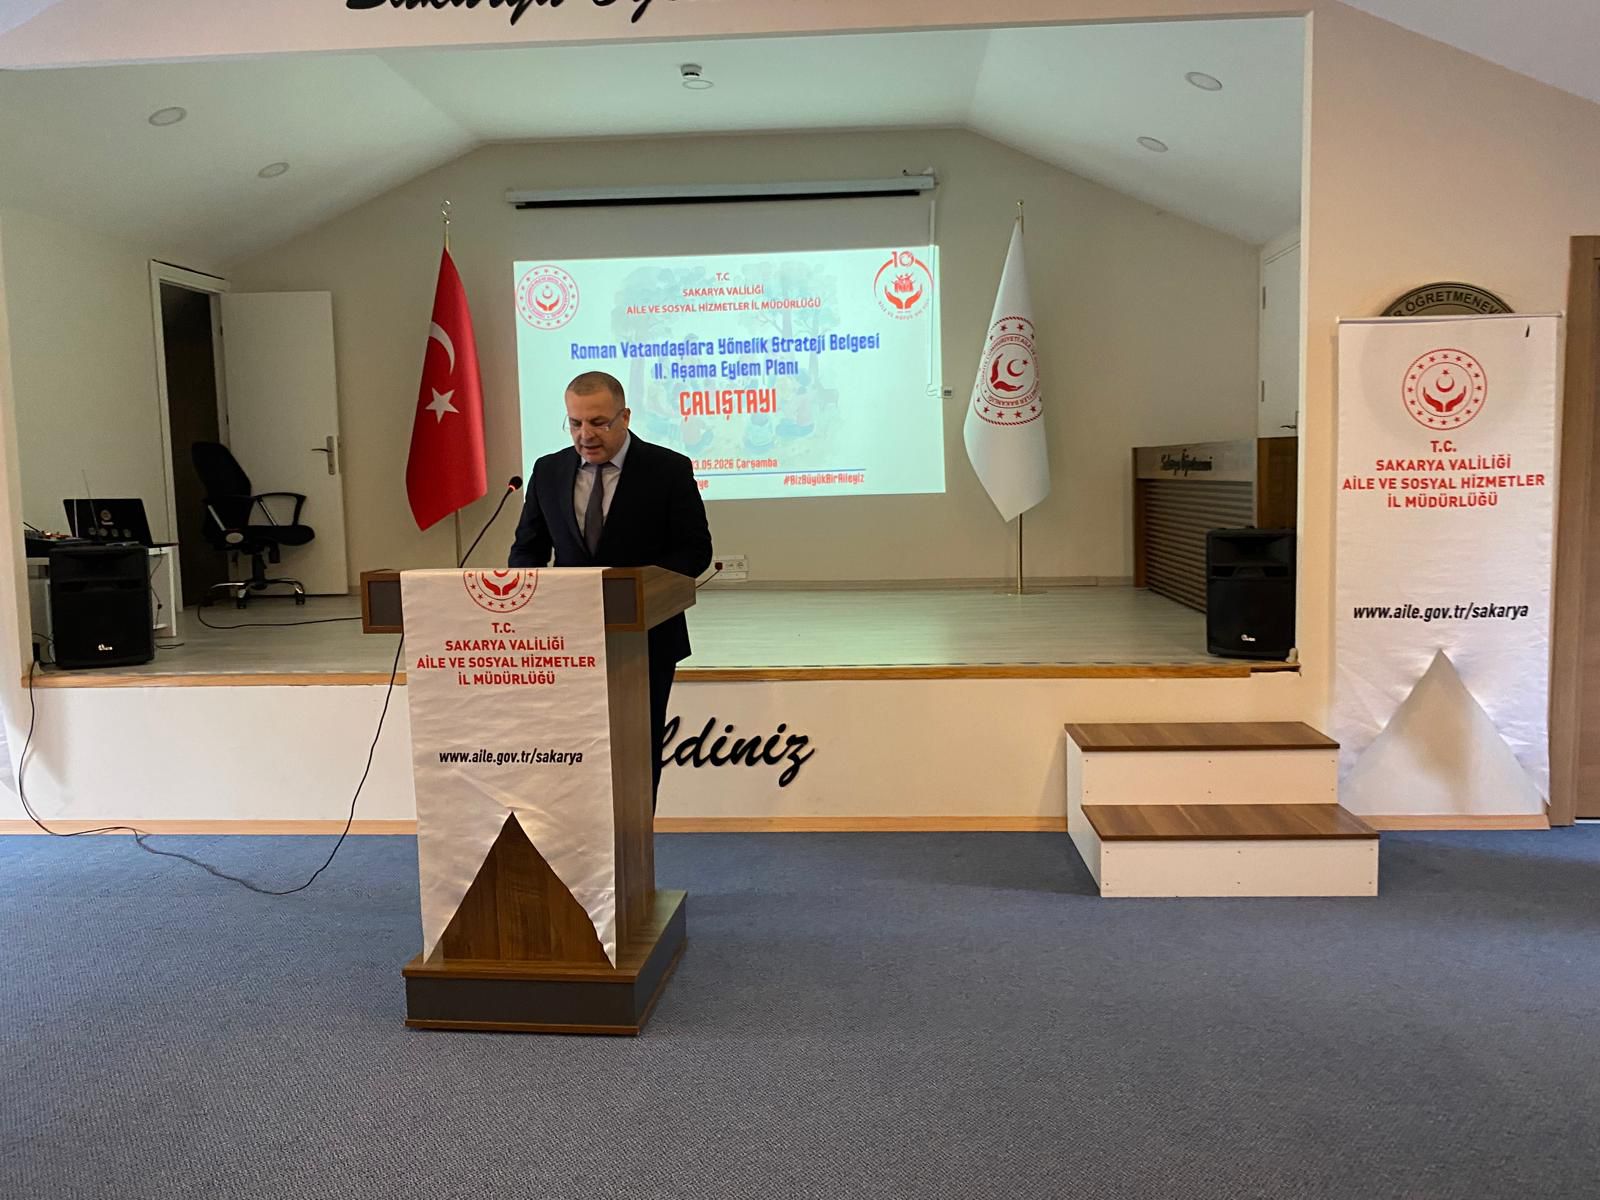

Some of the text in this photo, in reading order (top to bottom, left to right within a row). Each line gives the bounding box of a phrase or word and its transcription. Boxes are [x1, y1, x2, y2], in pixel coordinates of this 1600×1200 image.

[682, 288, 725, 297] SAKARYA
[626, 297, 821, 315] AİLE VE SOSYAL HİZMETLER İL MÜDÜRLÜĞÜ
[571, 332, 880, 360] Roman Vatandaşlara Yönelik Strateji Belgesi
[671, 362, 717, 381] Aşama
[721, 360, 761, 380] Eylem
[765, 358, 799, 376] Planı
[679, 388, 777, 422] ÇALIŞTAYI
[1430, 440, 1457, 453] T.C.
[1376, 454, 1512, 471] SAKARYA VALİLİĞİ
[1342, 473, 1545, 490] AİLE VE SOSYAL HİZMETLER
[1387, 492, 1498, 508] İL MÜDÜRLÜĞÜ
[1353, 602, 1529, 623] www.aile.gov.tr/sakarya
[491, 622, 516, 634] T.C.
[445, 636, 565, 651] SAKARYA VALİLİĞİ
[416, 654, 596, 669] AİLE VE SOSYAL HİZMETLER
[458, 671, 555, 685] İL MÜDÜRLÜĞÜ
[439, 748, 583, 766] www.aile.gov.tr/sakarya
[662, 715, 816, 788] ldiniz
